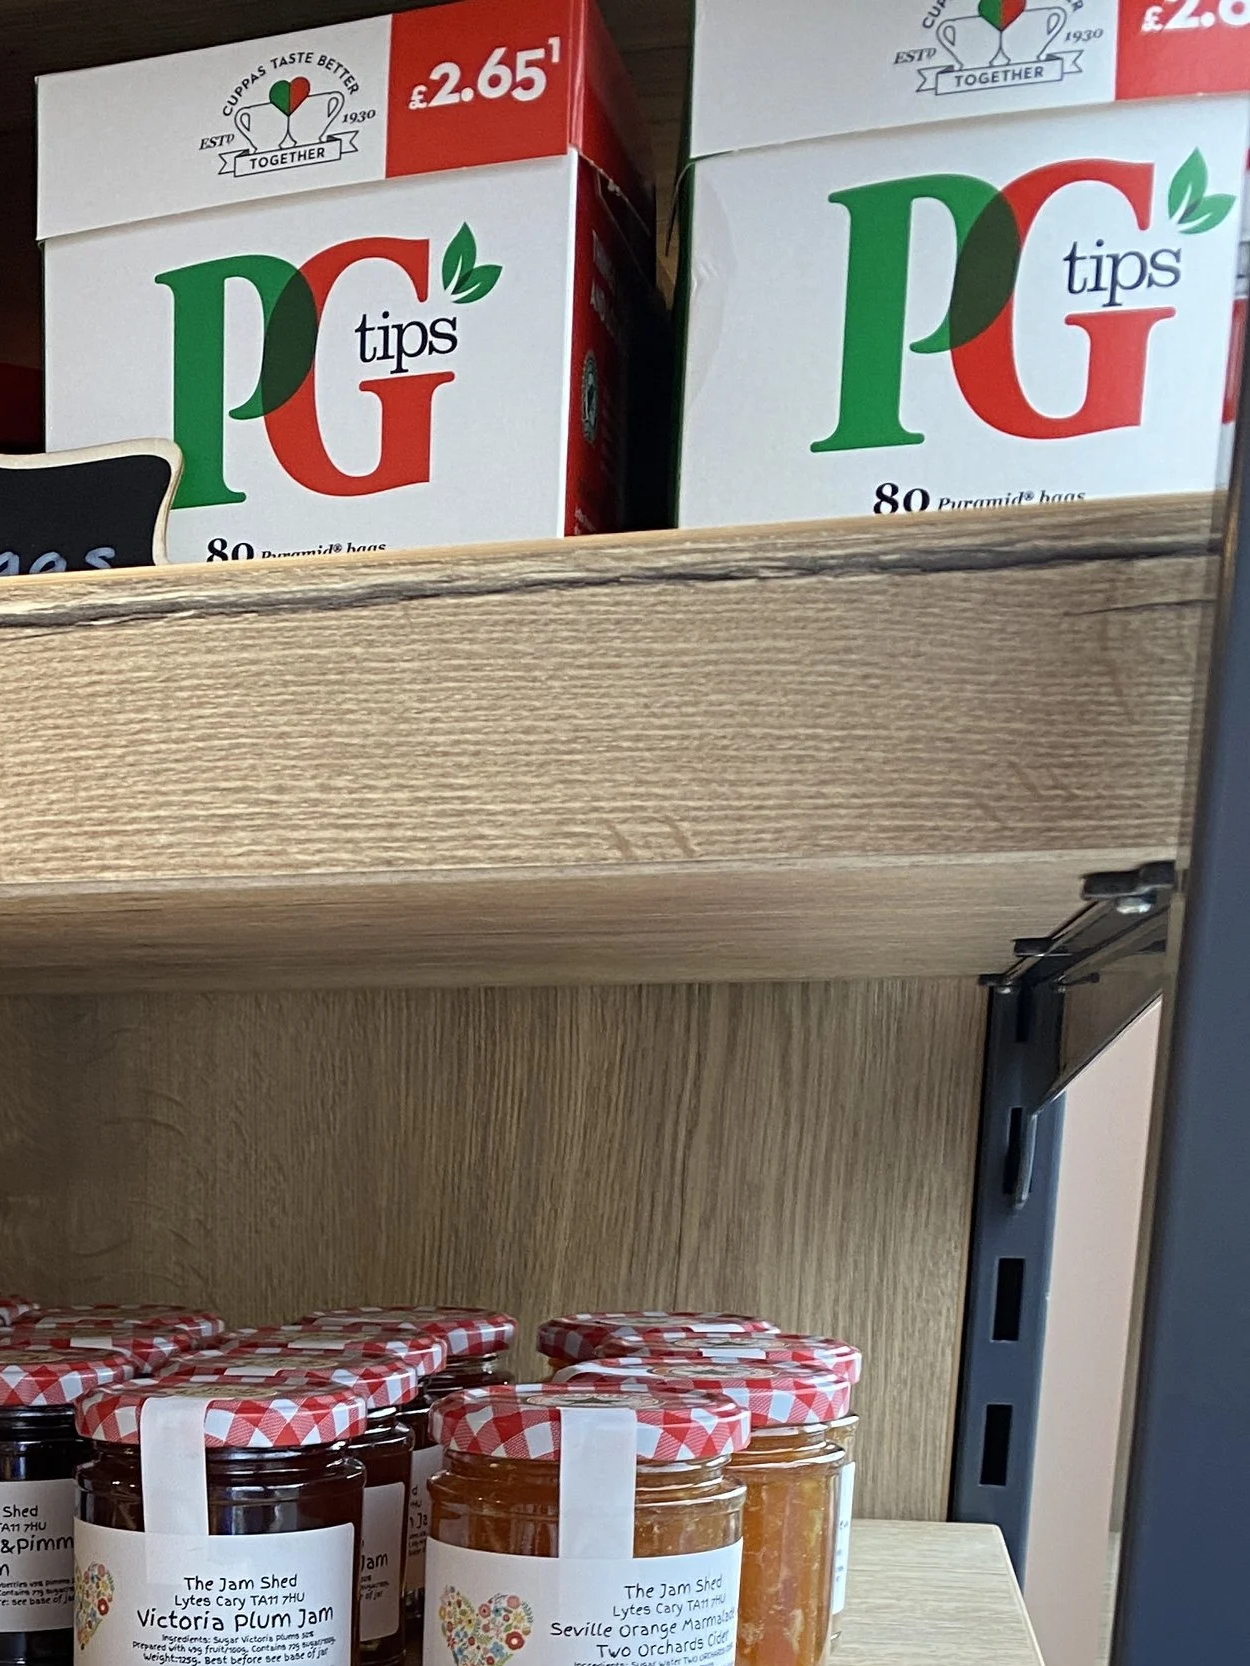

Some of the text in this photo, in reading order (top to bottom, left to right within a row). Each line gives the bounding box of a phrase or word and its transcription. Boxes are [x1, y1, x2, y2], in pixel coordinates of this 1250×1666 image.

[1065, 29, 1103, 42] 1930
[223, 52, 360, 116] CUPPAS TASTE BETTER
[955, 67, 1044, 87] TOGETHER
[342, 110, 376, 122] 1930
[250, 148, 324, 169] TOGETHER
[1063, 239, 1182, 308] tips
[810, 159, 1177, 453] PG
[355, 309, 458, 374] tips
[154, 236, 455, 510] PG
[873, 482, 930, 514] 80
[3, 1505, 38, 1517] Shed
[184, 1574, 297, 1592] The Jam Shed
[624, 1574, 722, 1599] The Jam Shed
[175, 1595, 211, 1610] Lytes
[216, 1596, 246, 1610] Cary
[613, 1605, 650, 1621] Lytes
[656, 1602, 683, 1617] Cary
[137, 1608, 224, 1631] Victoria
[298, 1606, 334, 1628] Jam
[550, 1622, 612, 1637] Seville
[620, 1622, 677, 1639] Orange
[597, 1630, 729, 1658] Two Orchards Cider
